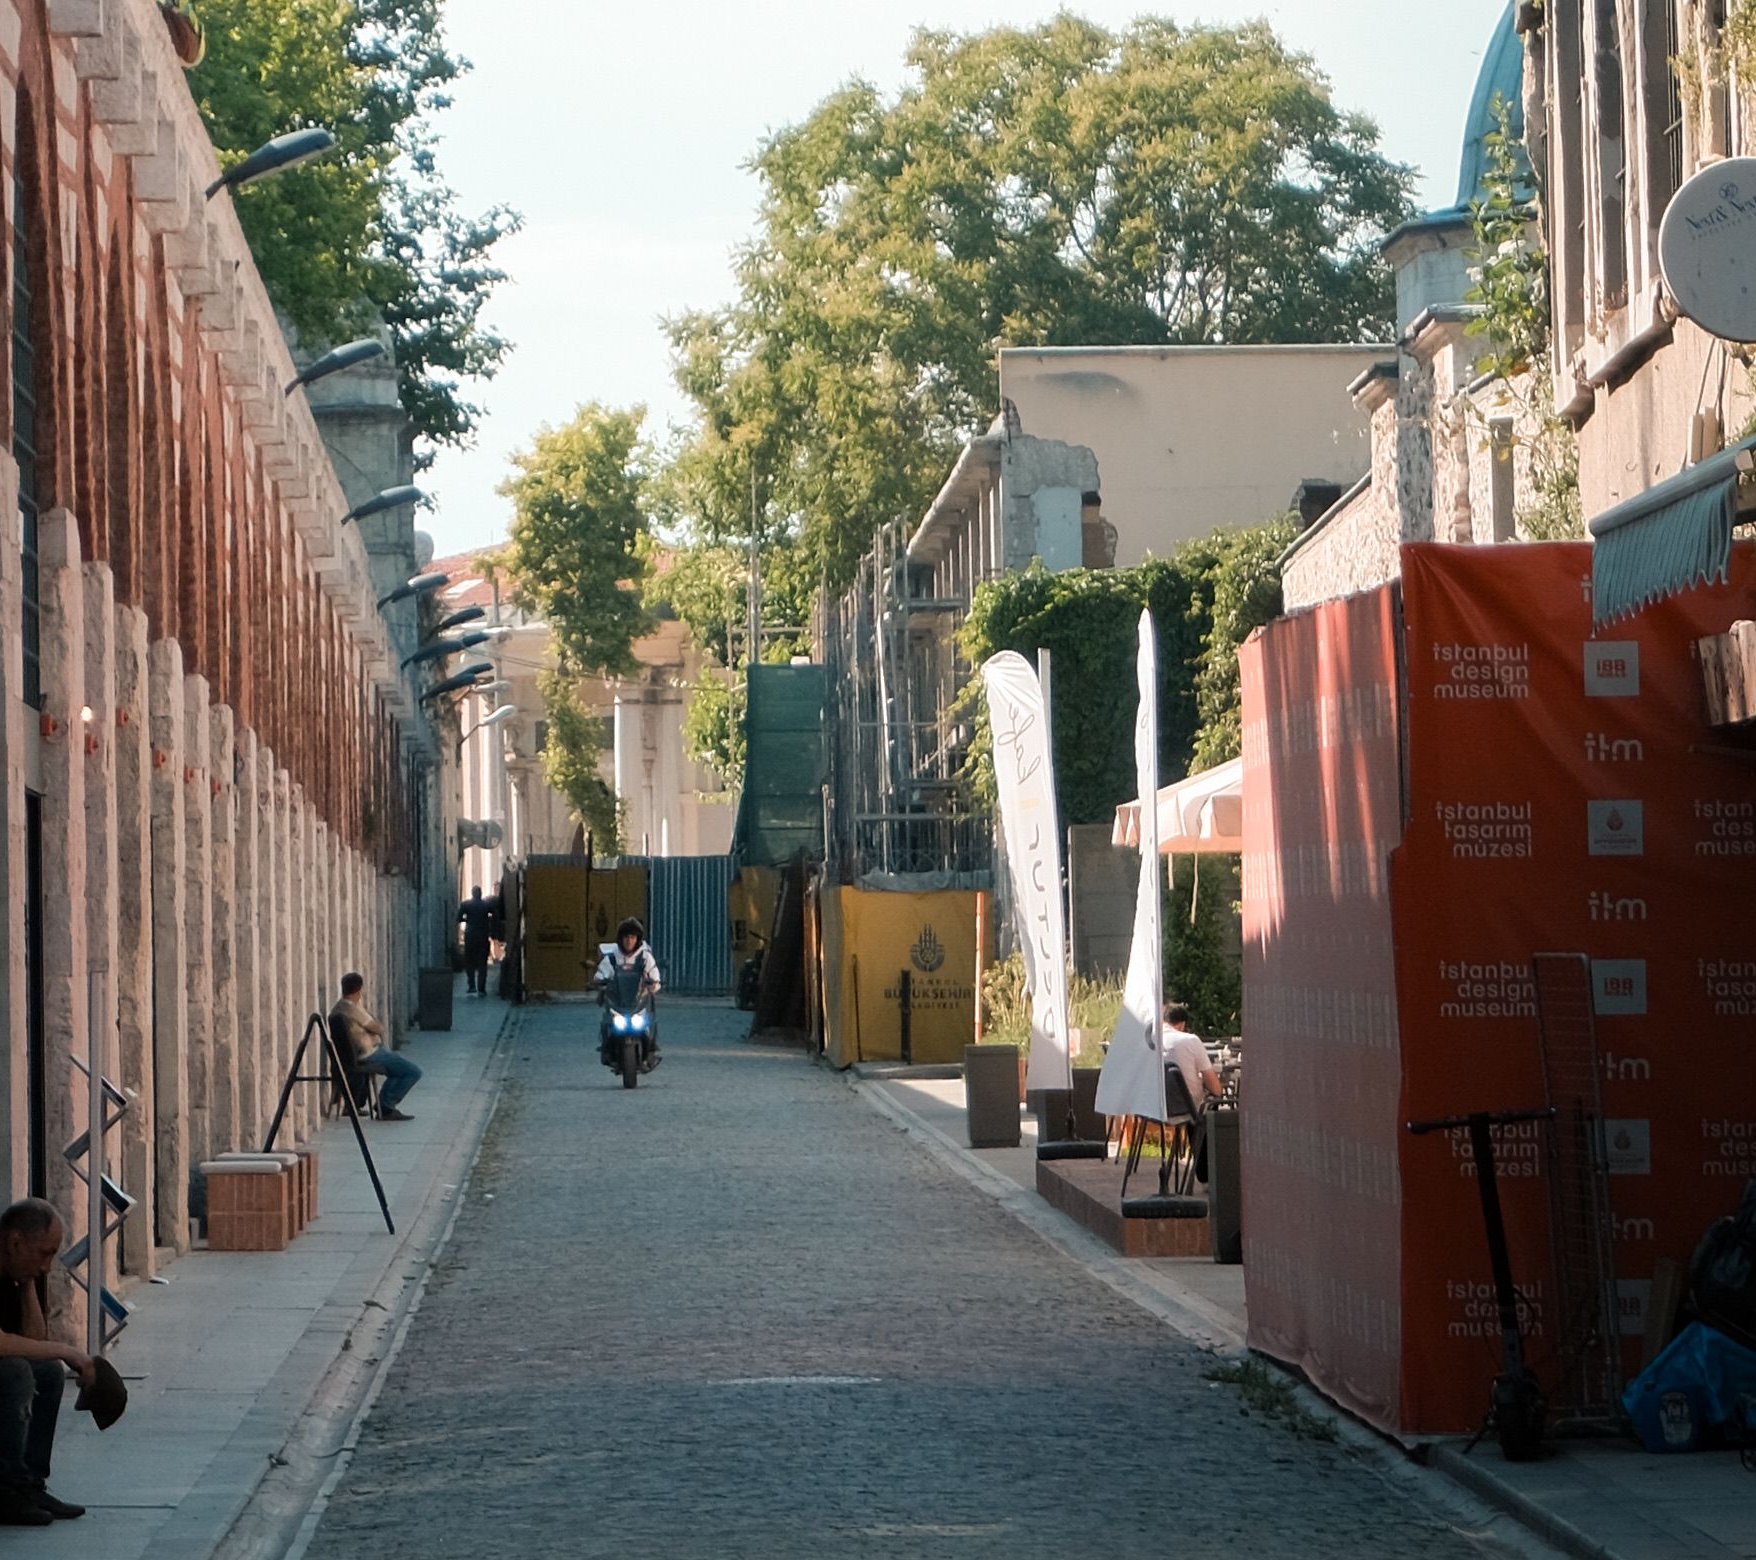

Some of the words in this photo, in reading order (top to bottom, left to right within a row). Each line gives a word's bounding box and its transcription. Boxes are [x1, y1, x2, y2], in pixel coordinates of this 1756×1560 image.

[1433, 642, 1529, 661] istanbul
[1450, 661, 1529, 683] design
[1433, 683, 1529, 699] museum
[1435, 800, 1532, 820] istanbul
[1439, 960, 1529, 980] istanbu
[1457, 980, 1535, 1001] design
[1439, 1001, 1536, 1018] museum
